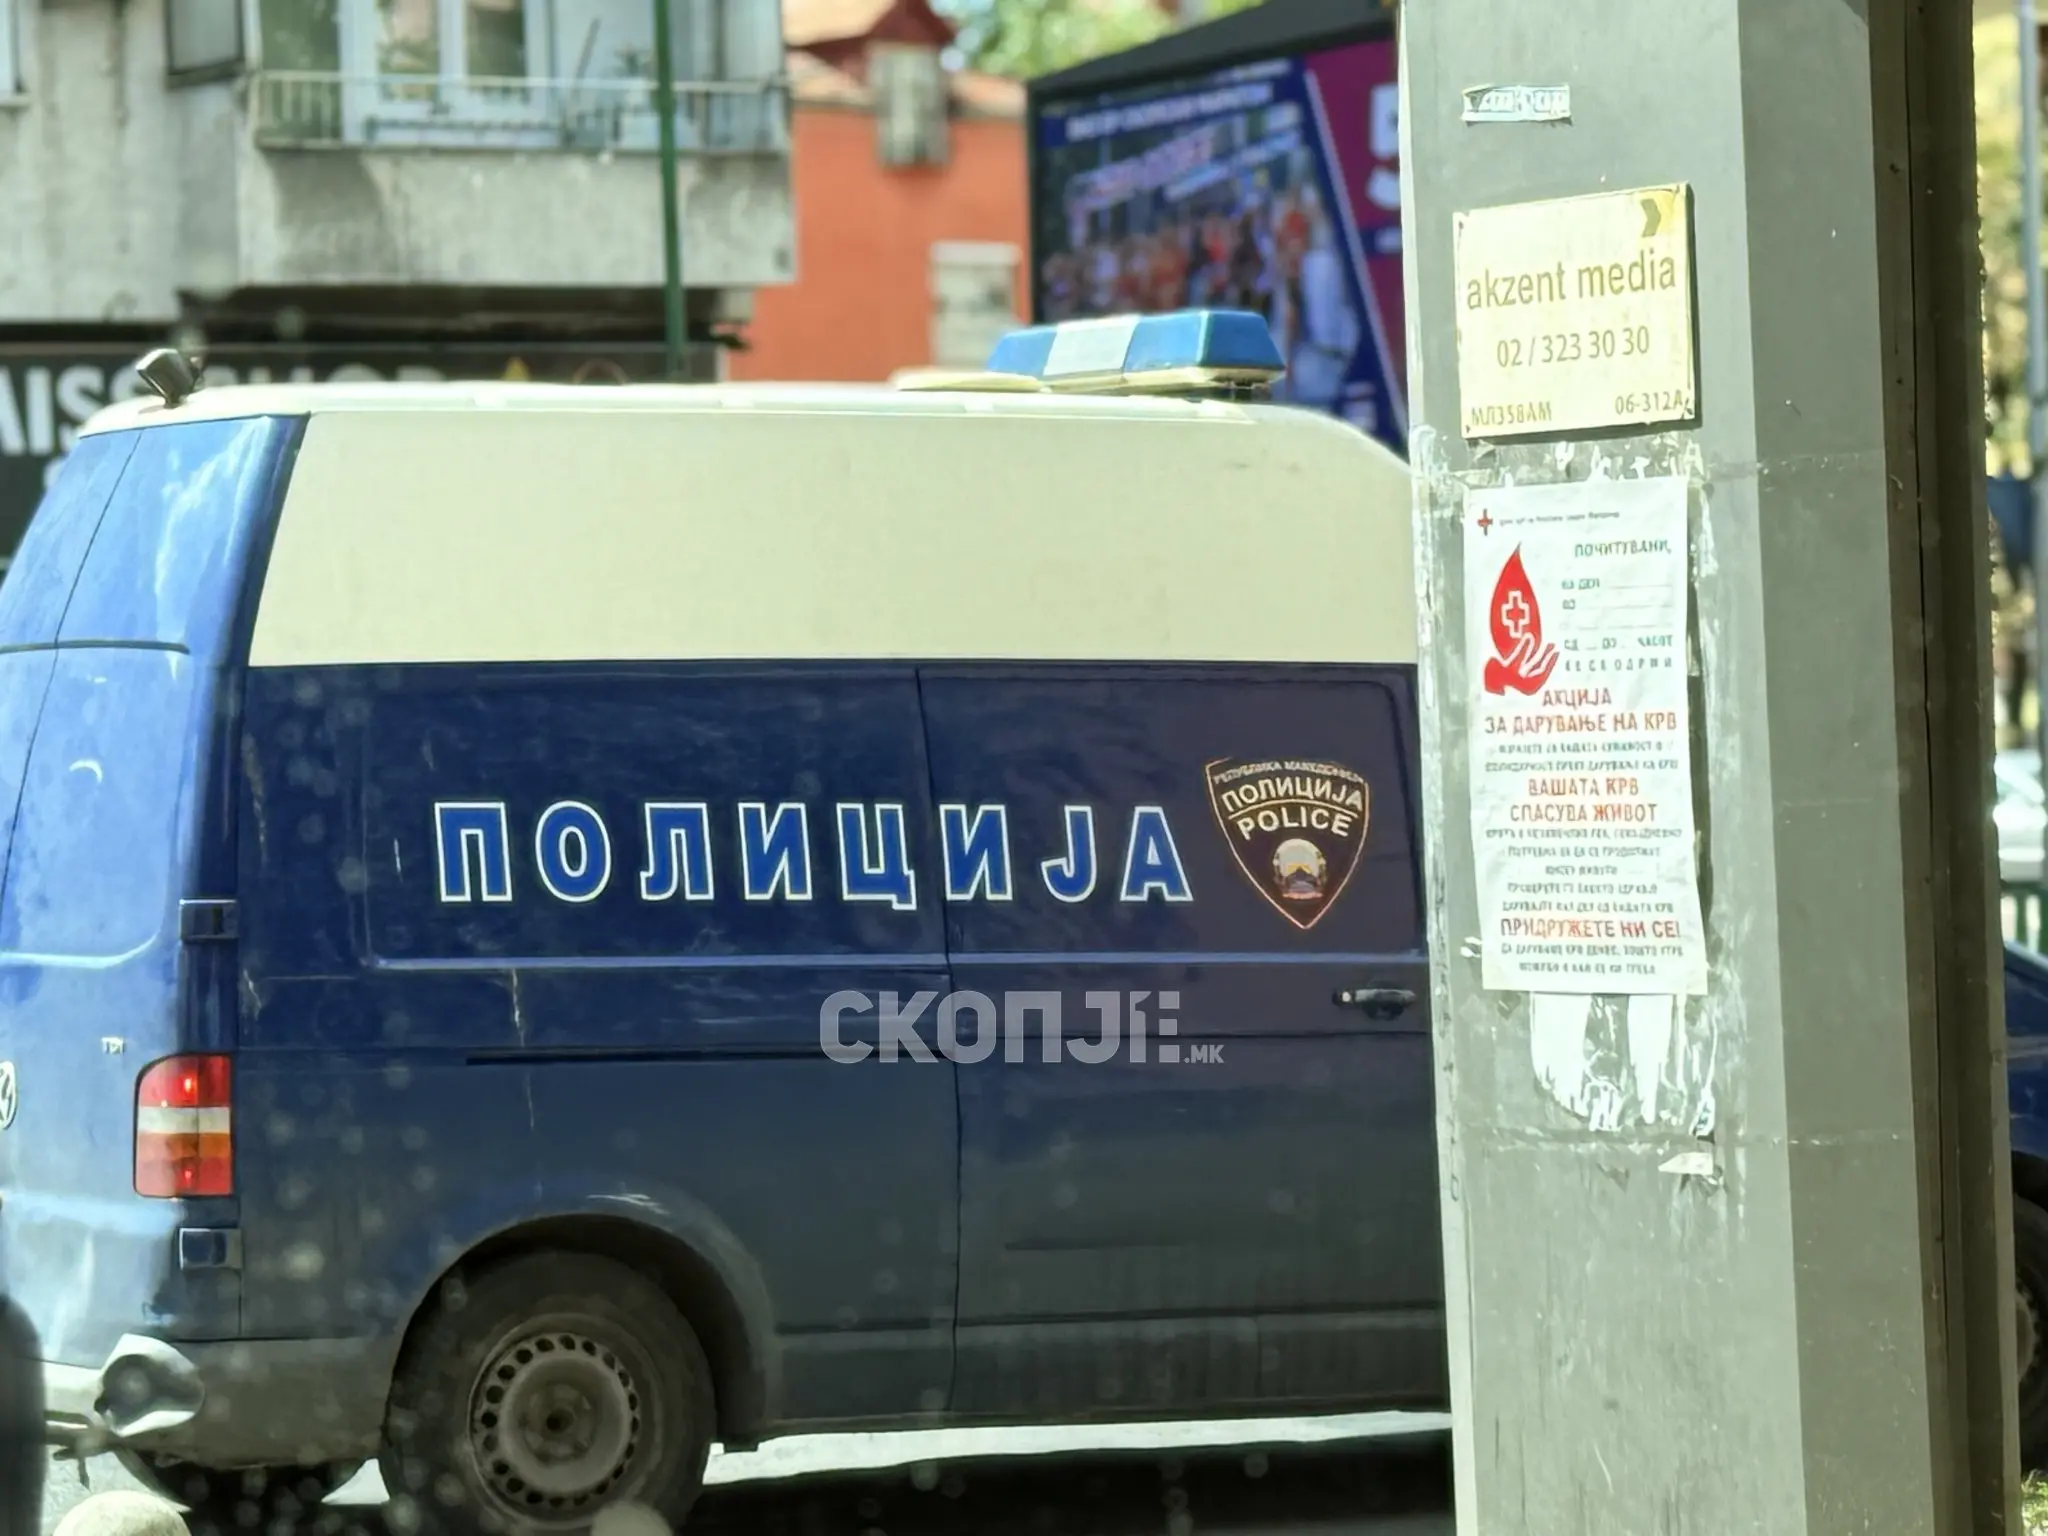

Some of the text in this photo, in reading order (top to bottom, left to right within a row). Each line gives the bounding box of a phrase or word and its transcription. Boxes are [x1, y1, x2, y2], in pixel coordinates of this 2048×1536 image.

[1466, 246, 1677, 311] akzent media
[1588, 329, 1616, 359] 30
[1622, 325, 1650, 355] 30
[1542, 687, 1612, 710] АКЦИЈА
[1484, 712, 1677, 735] ЗА ДАРУВАЊЕ НА КРВ
[1221, 776, 1363, 813] ПОЛИЦИЈА
[1528, 777, 1639, 796] ВАШАТА КРВ
[1236, 805, 1353, 841] POLICE
[1510, 803, 1657, 822] СПАСУВА ЖИВОТ
[434, 800, 1194, 911] ПОЛИЦИЈА
[1500, 918, 1615, 939] ПРИДРУЖЕТЕ
[1620, 921, 1646, 938] НИ
